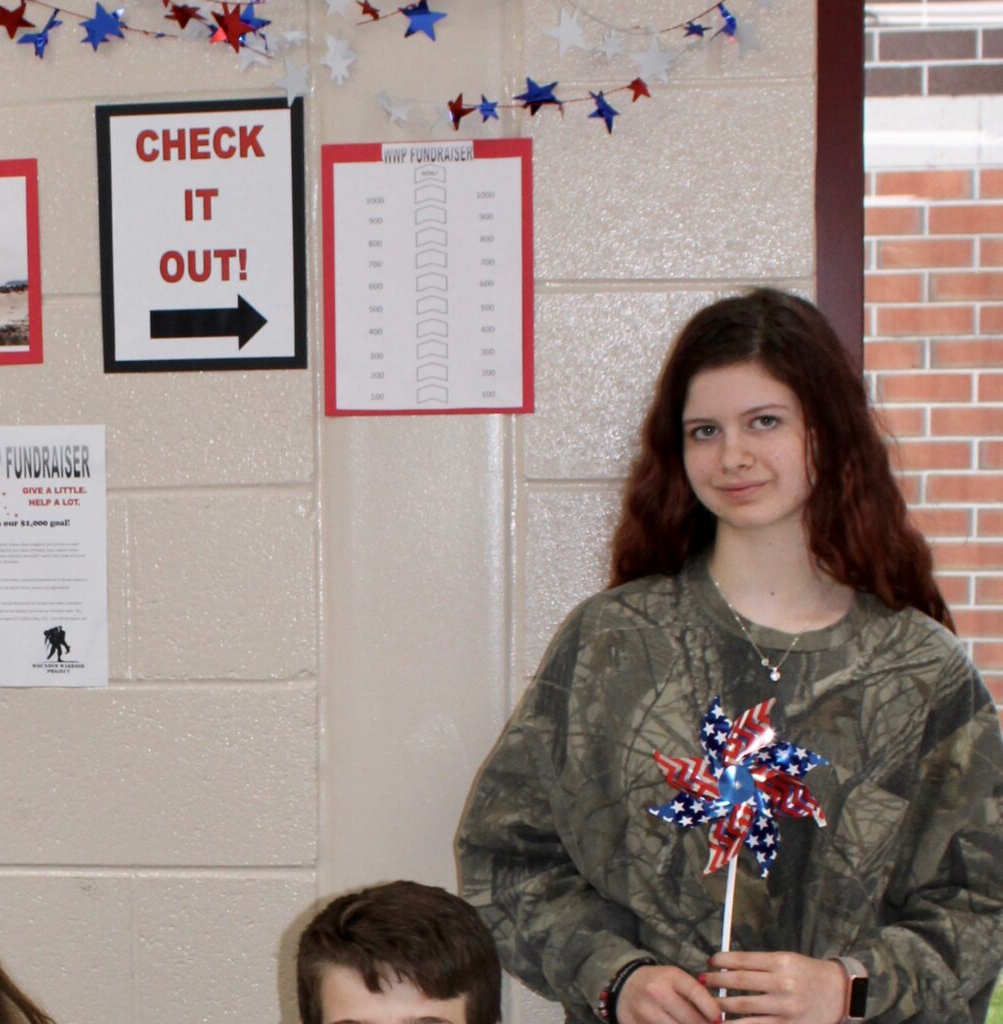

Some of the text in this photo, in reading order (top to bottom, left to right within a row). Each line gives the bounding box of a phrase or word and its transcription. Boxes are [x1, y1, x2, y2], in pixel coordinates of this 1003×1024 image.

[136, 125, 265, 162] CHECK
[384, 146, 473, 164] WWP FUNDRAISER
[184, 188, 219, 221] IT
[366, 197, 385, 205] 1000
[477, 191, 495, 199] 1000
[159, 248, 248, 283] OUT!
[5, 445, 90, 479] FUNDRAISER
[21, 520, 46, 528] $1,000
[50, 519, 70, 528] goal!
